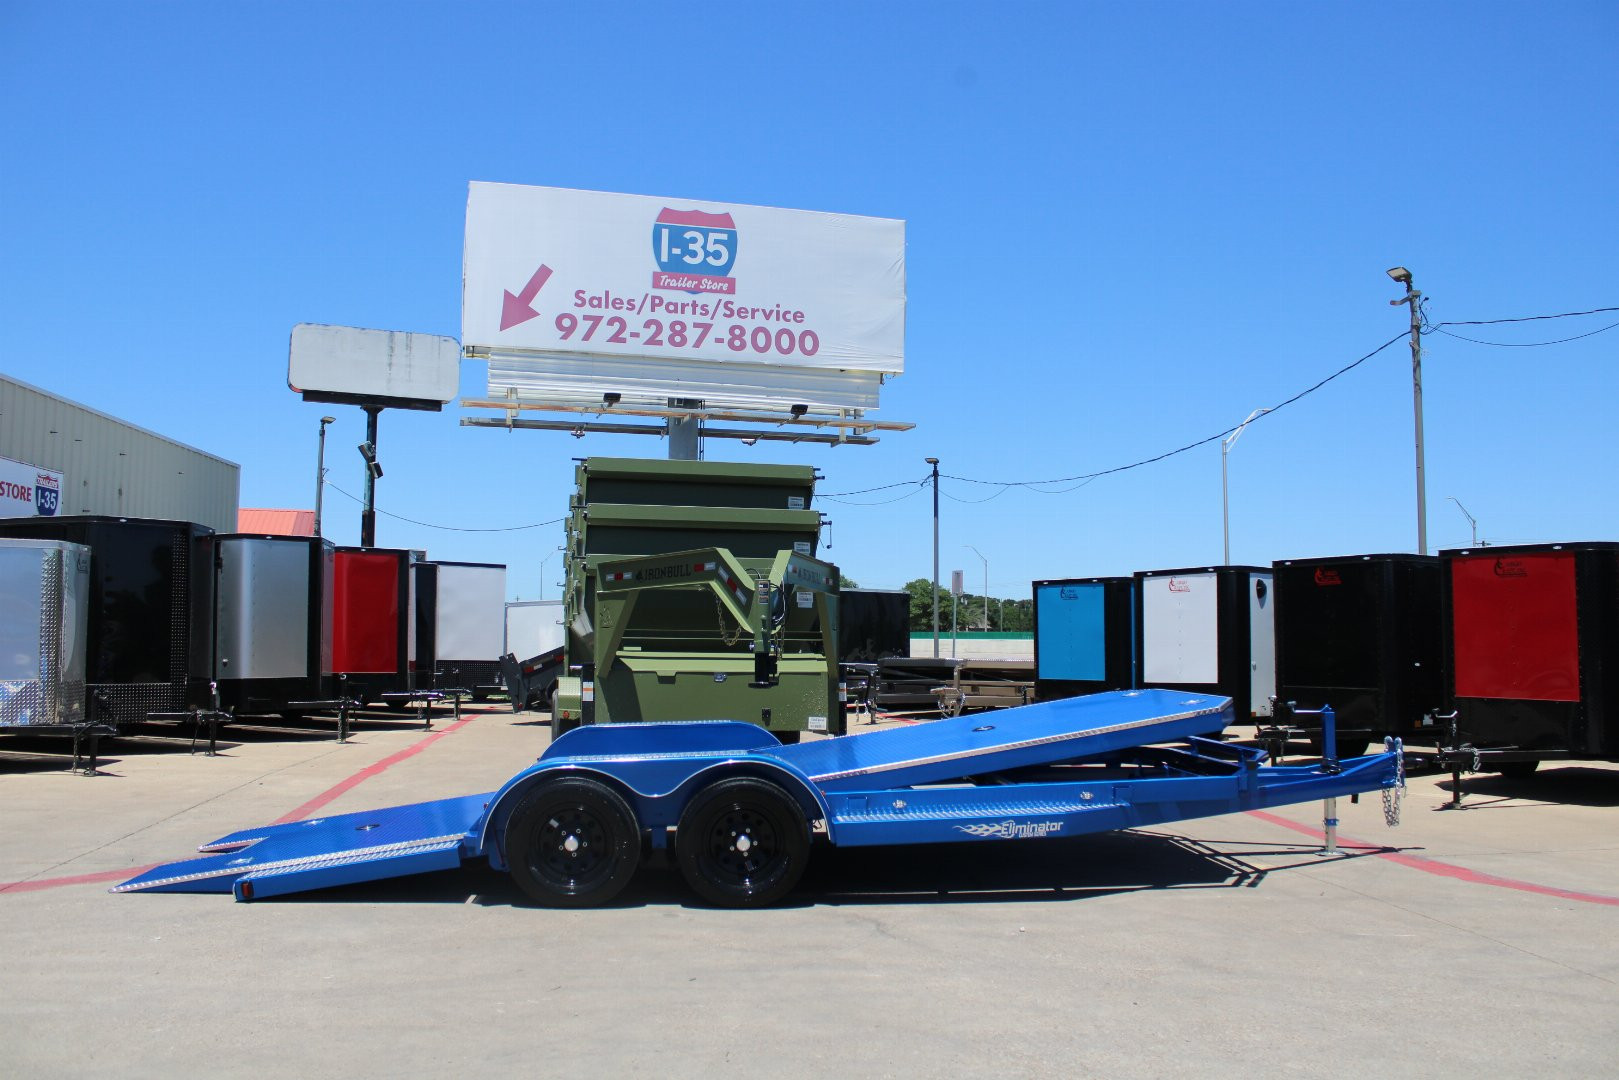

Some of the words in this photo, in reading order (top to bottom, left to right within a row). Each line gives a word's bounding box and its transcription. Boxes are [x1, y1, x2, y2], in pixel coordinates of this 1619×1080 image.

[661, 228, 729, 267] I-35
[659, 275, 698, 289] Trailer
[699, 278, 729, 291] Store
[574, 289, 805, 325] Sales/Parts/Service
[555, 312, 819, 357] 972-287-8000
[0, 480, 32, 502] STORE
[38, 489, 57, 510] I-35
[645, 561, 692, 582] IRONBULL
[1001, 821, 1063, 835] Eliminator
